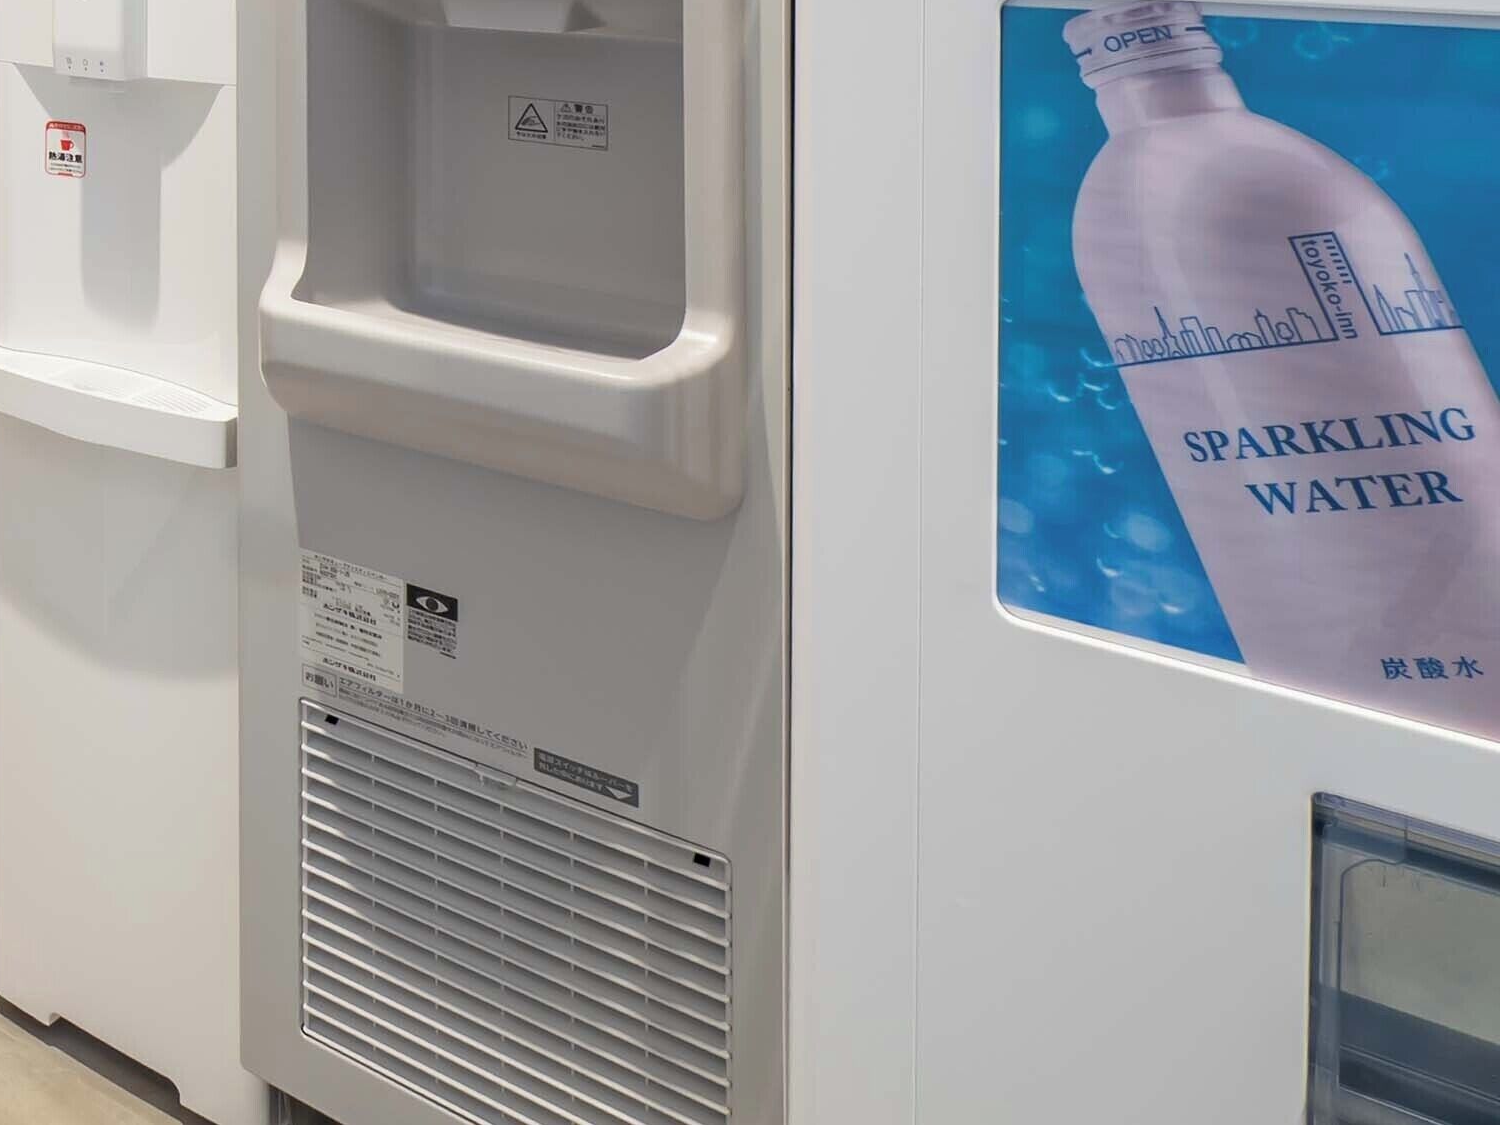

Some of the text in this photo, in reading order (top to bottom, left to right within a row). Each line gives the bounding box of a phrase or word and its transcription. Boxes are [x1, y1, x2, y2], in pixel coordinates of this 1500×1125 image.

[1103, 25, 1174, 53] OPEN
[1300, 238, 1358, 340] toyoko-inn
[1183, 407, 1476, 464] SPARKLING
[1244, 470, 1464, 516] WATER
[1381, 657, 1484, 682] 炭酸水
